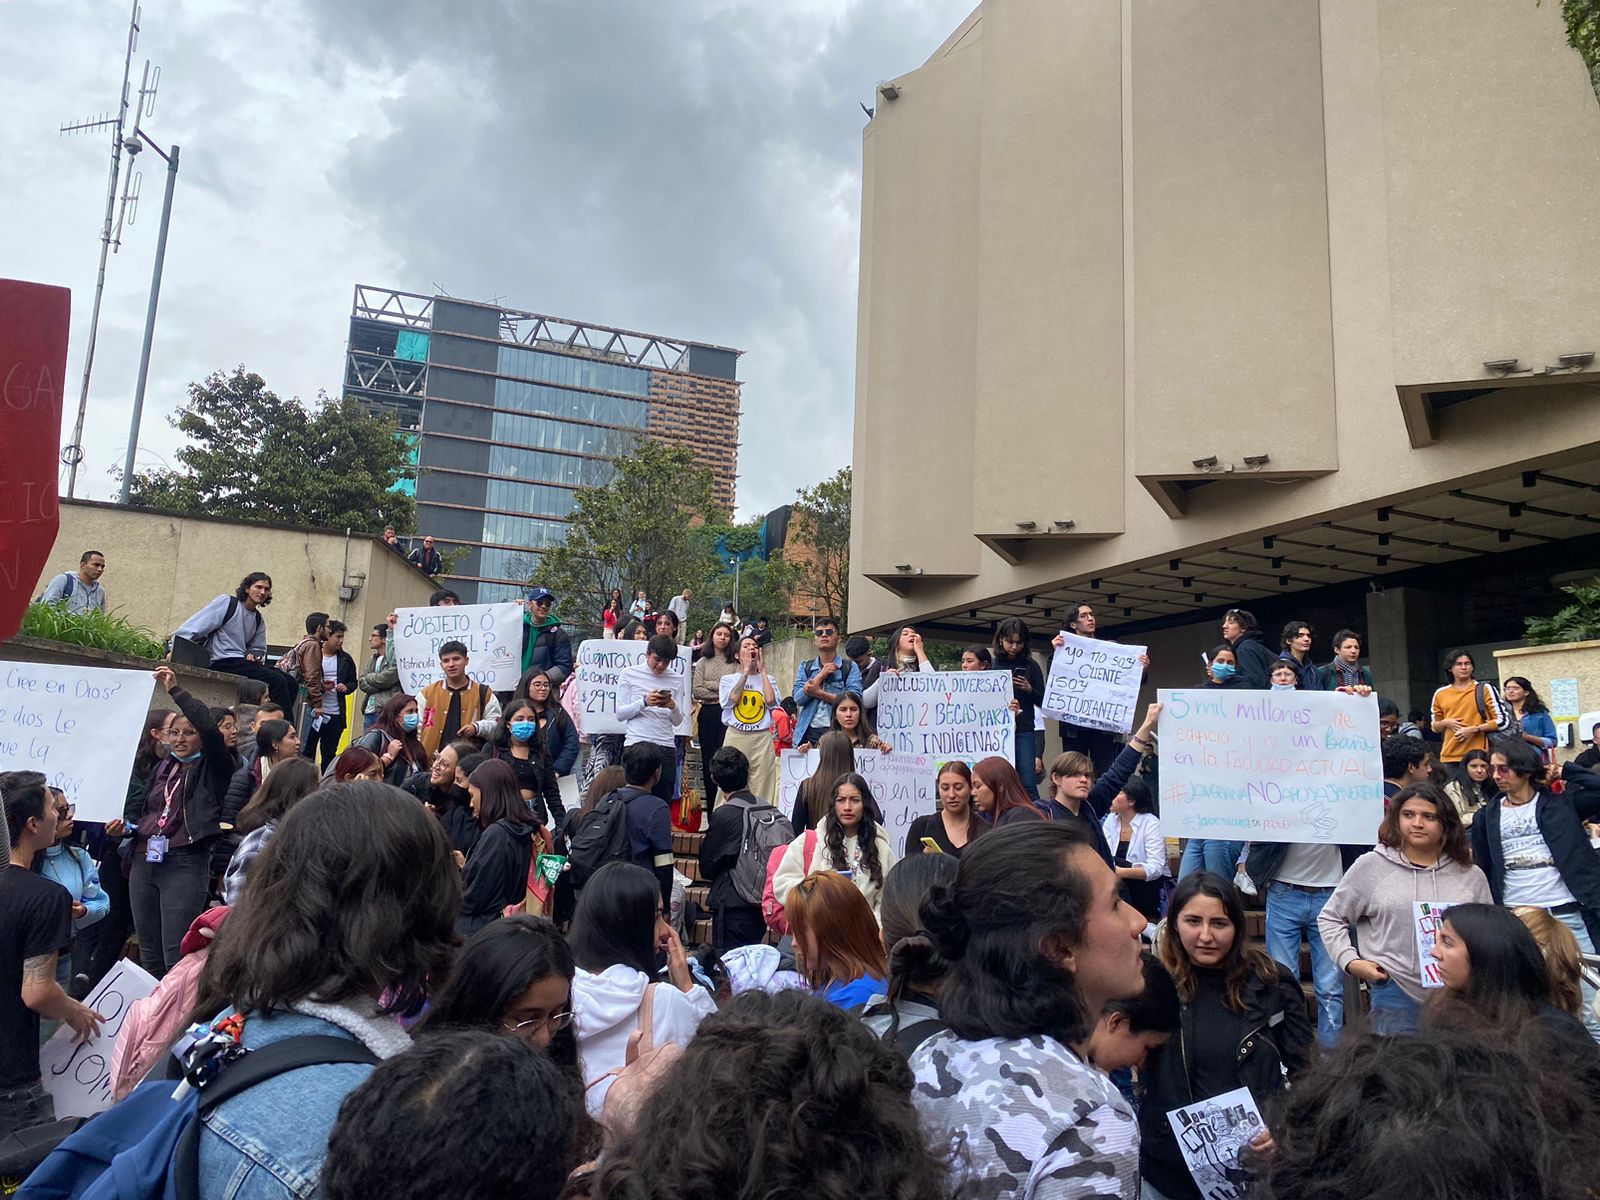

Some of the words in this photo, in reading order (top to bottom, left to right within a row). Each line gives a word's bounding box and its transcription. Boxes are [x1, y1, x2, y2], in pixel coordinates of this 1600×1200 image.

[403, 613, 470, 638] ¿OBJETO
[480, 608, 494, 632] Ó
[6, 668, 37, 692] Cree
[45, 681, 65, 694] en
[75, 679, 122, 700] Dios?
[951, 675, 1008, 693] DIVERSA?
[1078, 664, 1122, 685] CLIENTE
[13, 705, 43, 728] dios
[878, 698, 915, 730] ¿SÓLO
[918, 702, 929, 727] 2
[935, 702, 977, 725] BECAS
[980, 707, 1011, 727] PARA
[1046, 692, 1128, 723] ESTUDIANTE!
[1169, 692, 1190, 719] 5
[1195, 695, 1228, 719] mil
[1235, 697, 1312, 725] millones
[1334, 708, 1358, 729] de
[733, 721, 761, 731] HAPPY
[1176, 726, 1231, 744] edificio
[1243, 736, 1252, 754] y
[1263, 735, 1279, 749] ni
[1291, 736, 1318, 749] un
[920, 728, 1009, 755] INDÍGENAS?
[1174, 751, 1194, 765] en
[1203, 747, 1218, 768] la
[1295, 757, 1379, 780] ACTUAL
[541, 858, 563, 872] ABO
